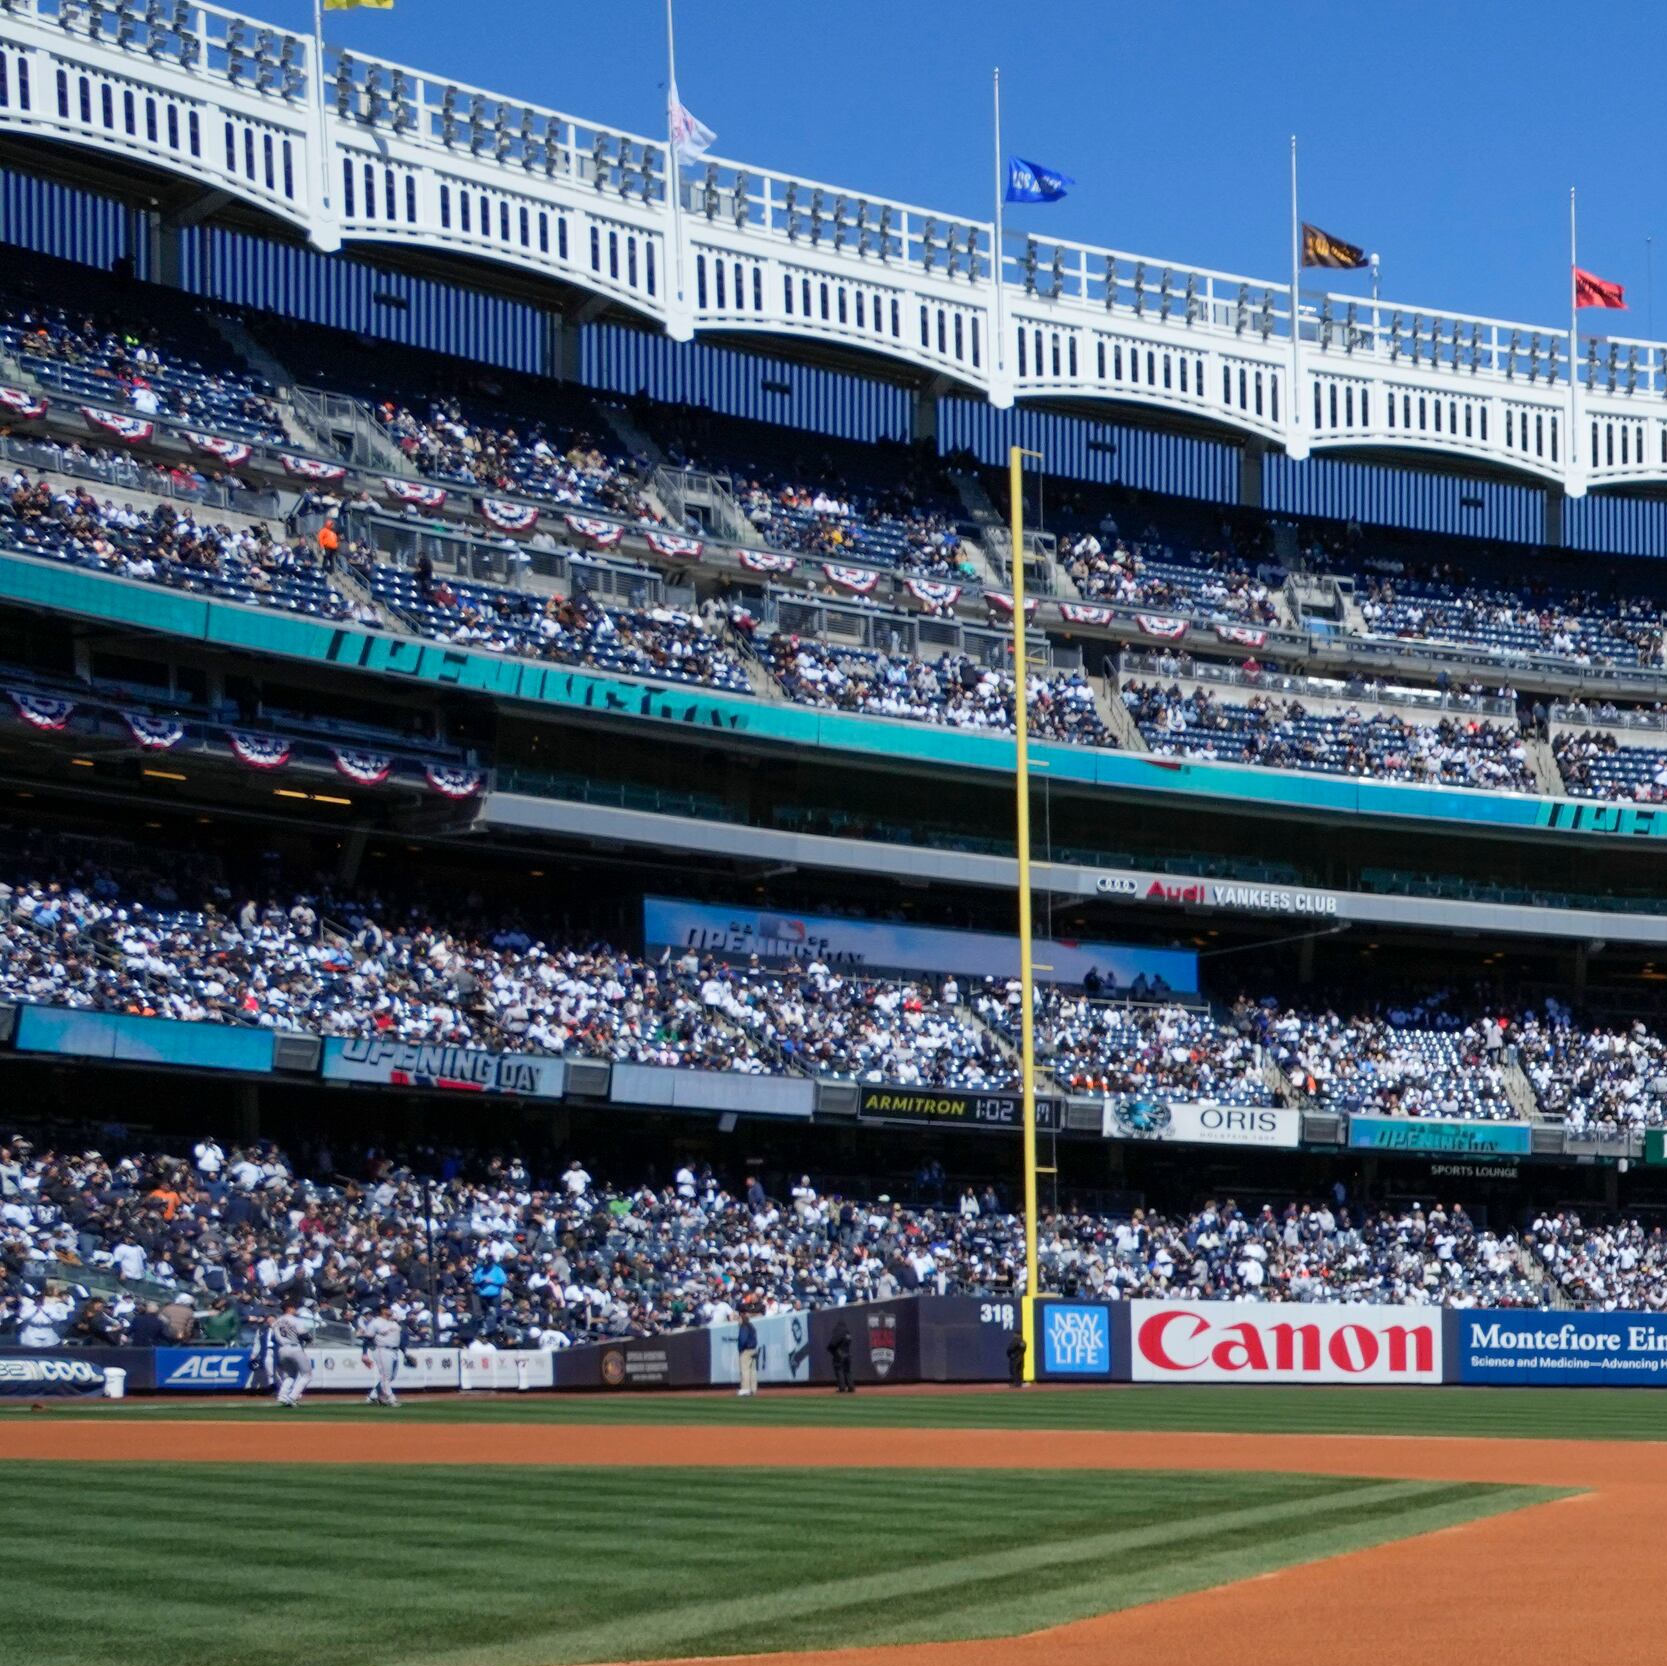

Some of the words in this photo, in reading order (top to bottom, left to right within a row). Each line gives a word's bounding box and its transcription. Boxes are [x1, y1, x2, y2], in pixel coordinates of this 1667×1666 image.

[1147, 880, 1206, 902] Audi
[1214, 886, 1290, 909] YANKEES
[1295, 893, 1337, 914] CLUB
[341, 1039, 498, 1084] OPENING
[500, 1060, 542, 1092] DAY
[865, 1095, 965, 1116] ARMITRON
[975, 1101, 1012, 1122] 1:02
[1199, 1109, 1277, 1132] ORIS
[1375, 1130, 1469, 1152] OPENING
[1431, 1165, 1474, 1177] SPORTS
[1475, 1167, 1518, 1179] LOUNGE
[980, 1304, 1013, 1323] 318
[1054, 1312, 1098, 1332] NEW
[1049, 1329, 1104, 1349] YORK
[1138, 1310, 1433, 1373] Canon
[1470, 1323, 1621, 1350] Montefiore
[1055, 1345, 1098, 1365] LIFE
[1471, 1355, 1515, 1368] Science
[1517, 1356, 1537, 1369] and
[40, 1360, 104, 1382] COOL
[172, 1356, 243, 1377] ACC
